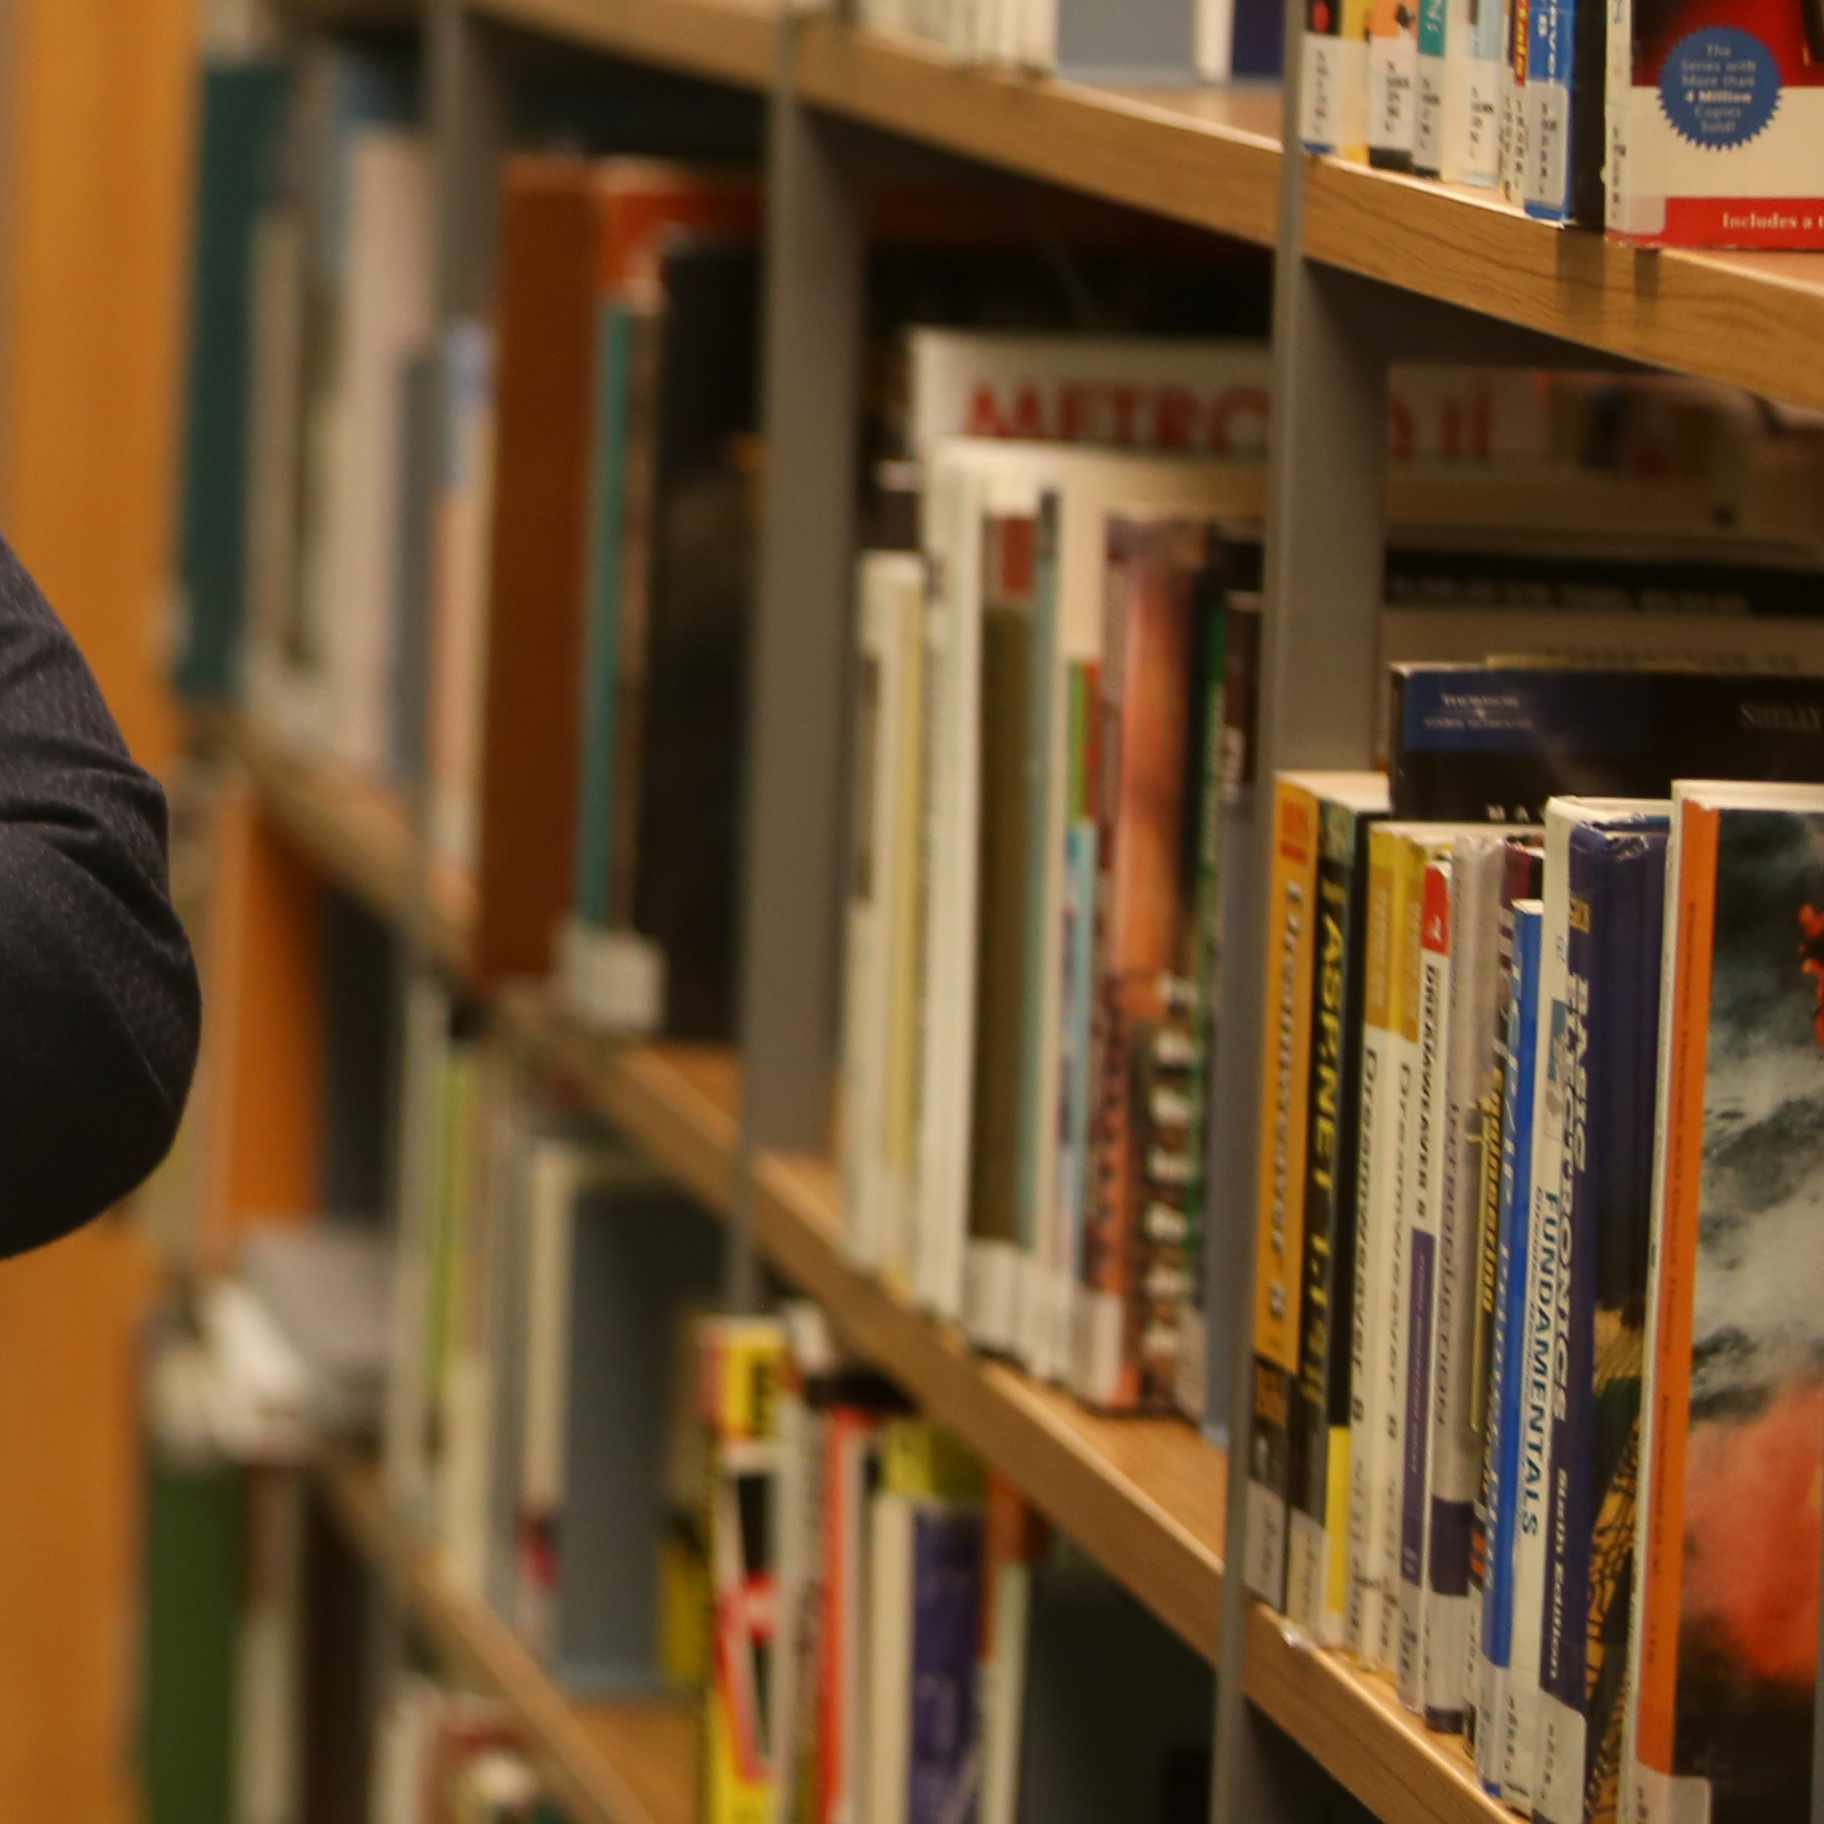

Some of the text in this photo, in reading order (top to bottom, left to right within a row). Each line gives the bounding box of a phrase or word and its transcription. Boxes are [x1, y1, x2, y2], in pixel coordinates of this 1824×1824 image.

[1698, 88, 1752, 105] Million
[1722, 212, 1798, 230] Includes
[1418, 963, 1443, 1190] DREAMWEAVER
[1522, 1188, 1559, 1538] FUNDAMENTALS
